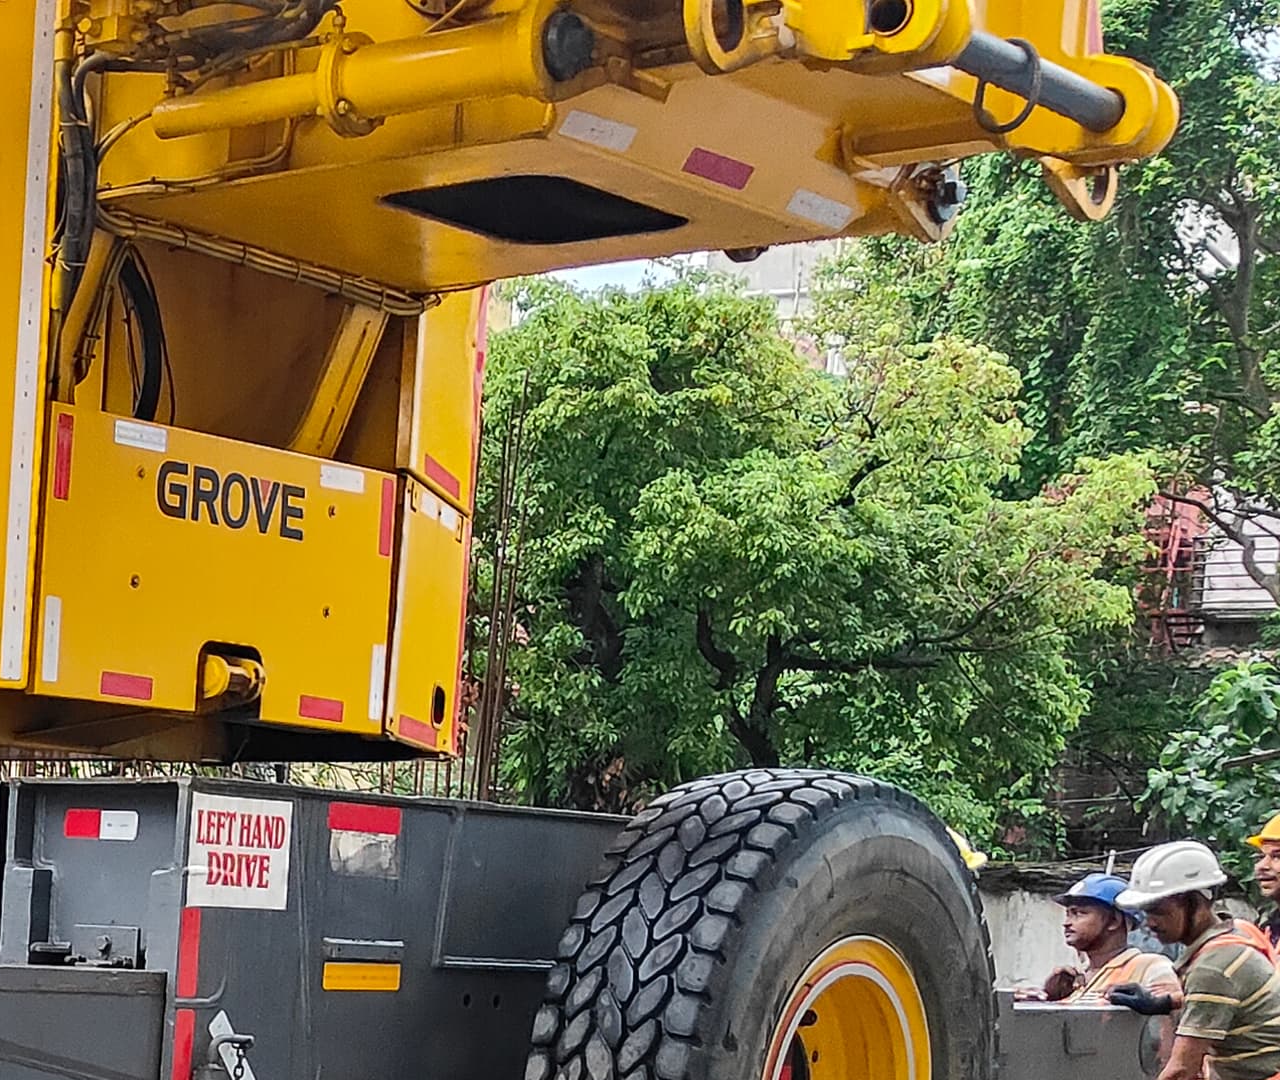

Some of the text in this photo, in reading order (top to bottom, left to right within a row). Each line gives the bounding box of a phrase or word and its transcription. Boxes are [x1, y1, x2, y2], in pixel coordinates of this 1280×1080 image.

[156, 460, 306, 541] GROVE
[196, 810, 285, 850] LEFT HAND
[206, 851, 270, 889] DRIVE
